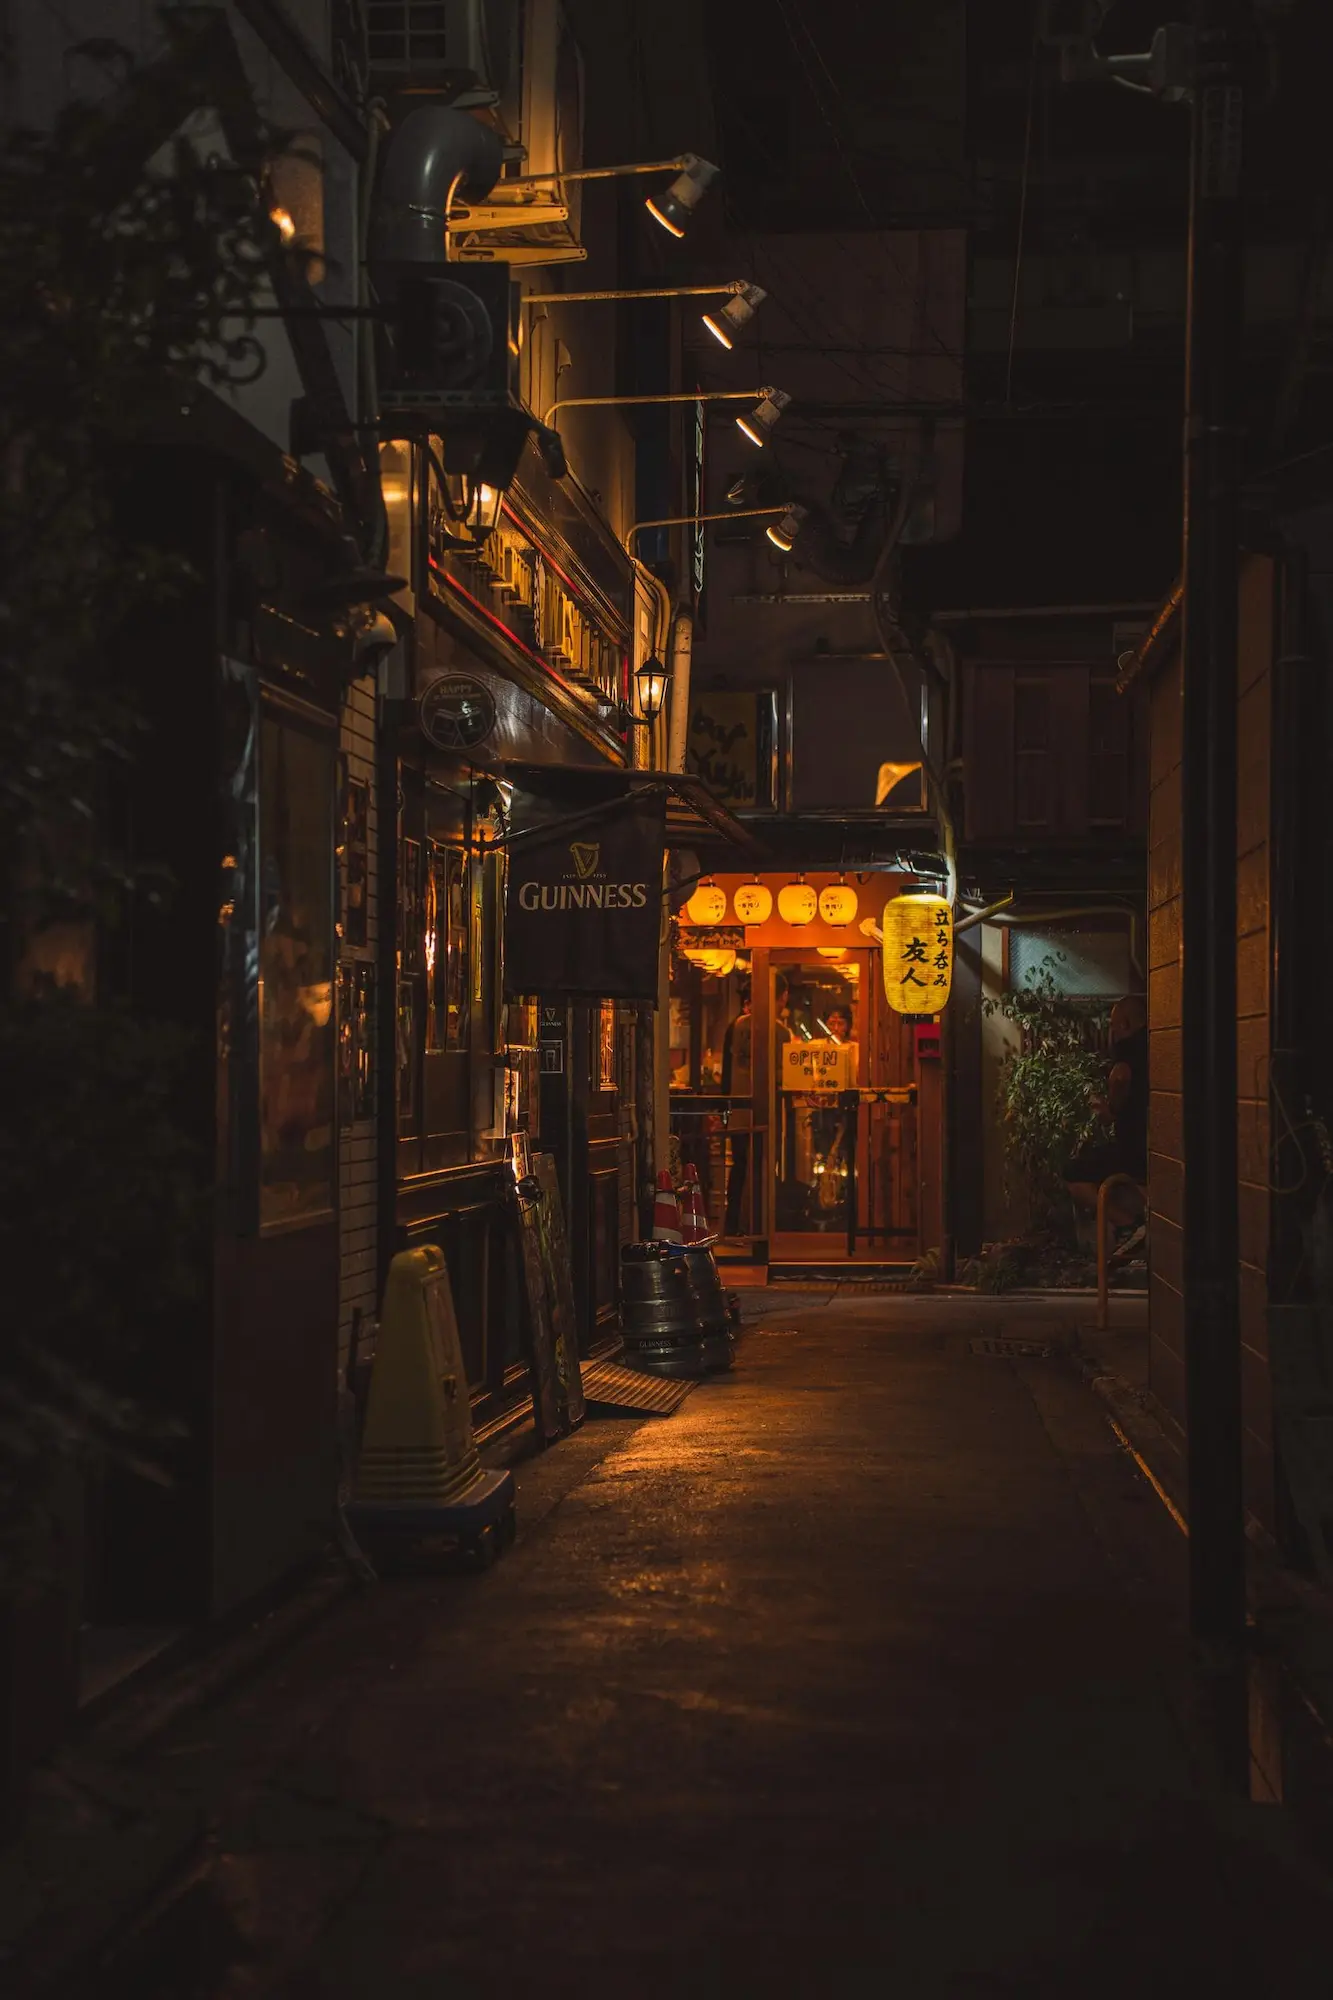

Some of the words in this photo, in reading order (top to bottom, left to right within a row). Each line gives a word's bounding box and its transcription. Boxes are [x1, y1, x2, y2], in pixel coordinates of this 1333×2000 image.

[519, 881, 648, 911] GUINNESS
[900, 936, 930, 987] 友人
[932, 908, 950, 987] 立ち呑み
[789, 1050, 838, 1066] OPEN
